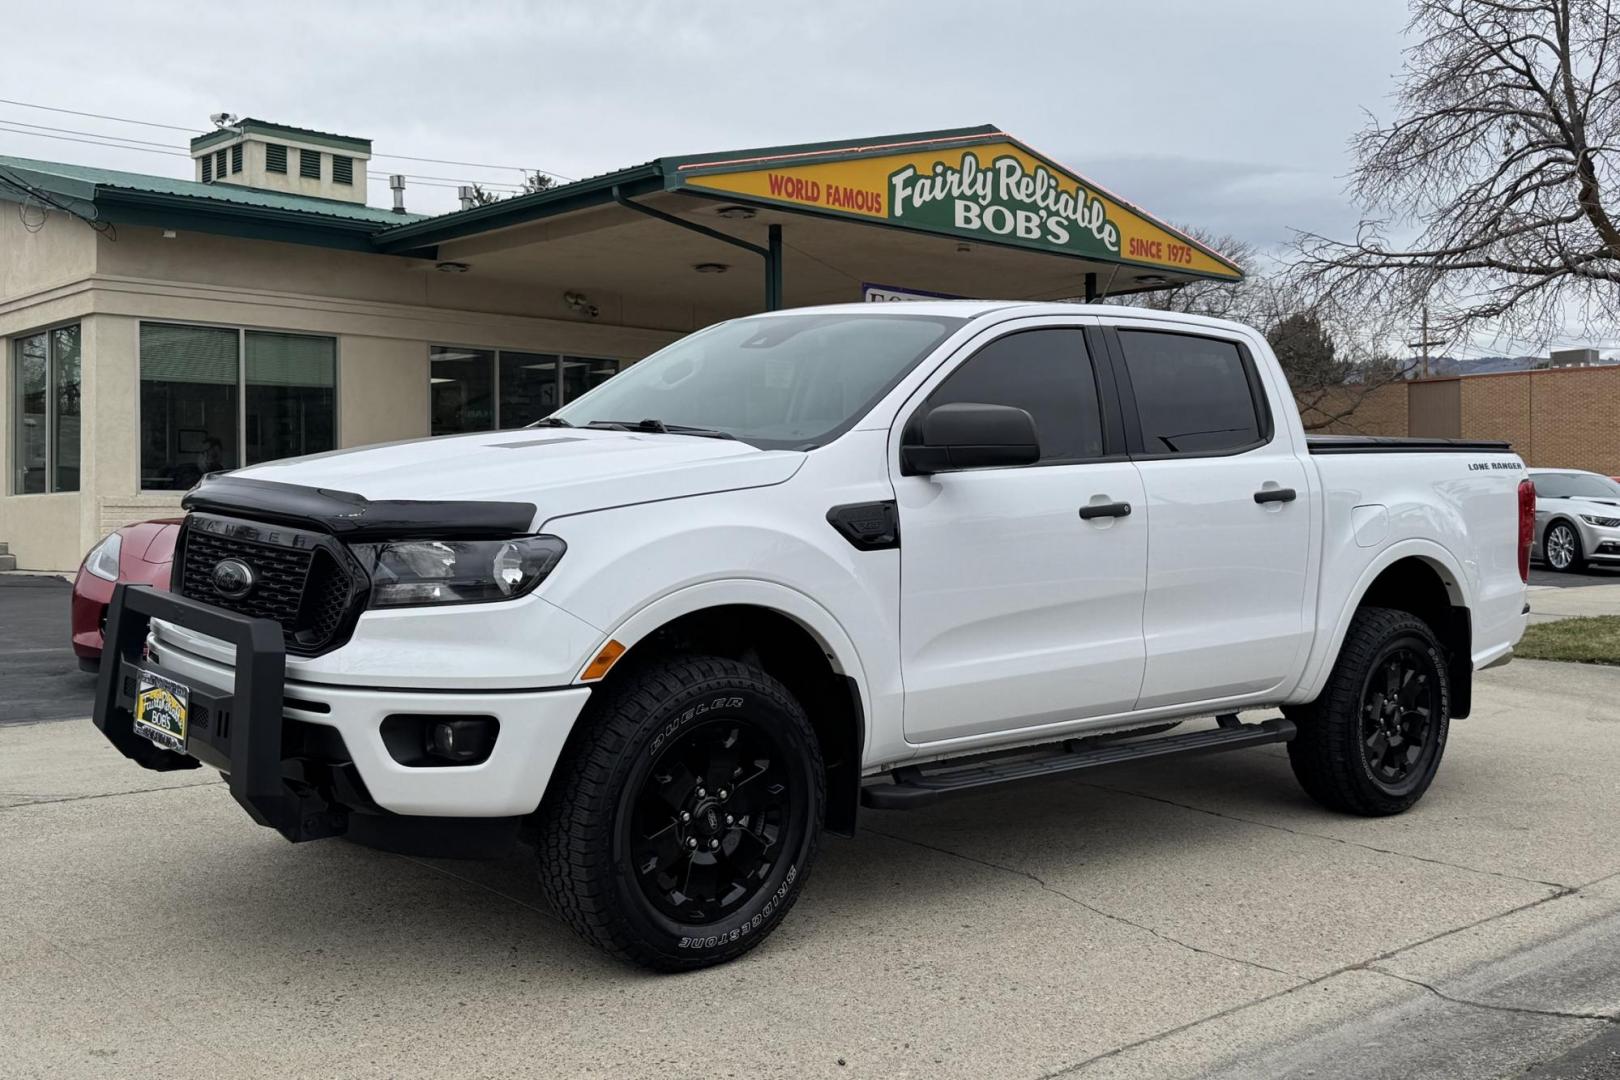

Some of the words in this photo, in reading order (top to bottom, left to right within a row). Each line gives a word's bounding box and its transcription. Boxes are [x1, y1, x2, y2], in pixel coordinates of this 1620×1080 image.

[768, 173, 820, 202] WORLD
[826, 184, 882, 214] FAMOUS
[892, 155, 993, 217] Fairly
[995, 158, 1119, 252] Reliable
[954, 199, 1070, 245] BOB'S
[1129, 237, 1162, 260] SINCE
[1167, 243, 1192, 264] 1975
[1467, 463, 1490, 471] LONE
[1491, 462, 1523, 470] RANGER
[650, 697, 744, 755] DUELER
[678, 864, 797, 948] BRIDGESTONE
